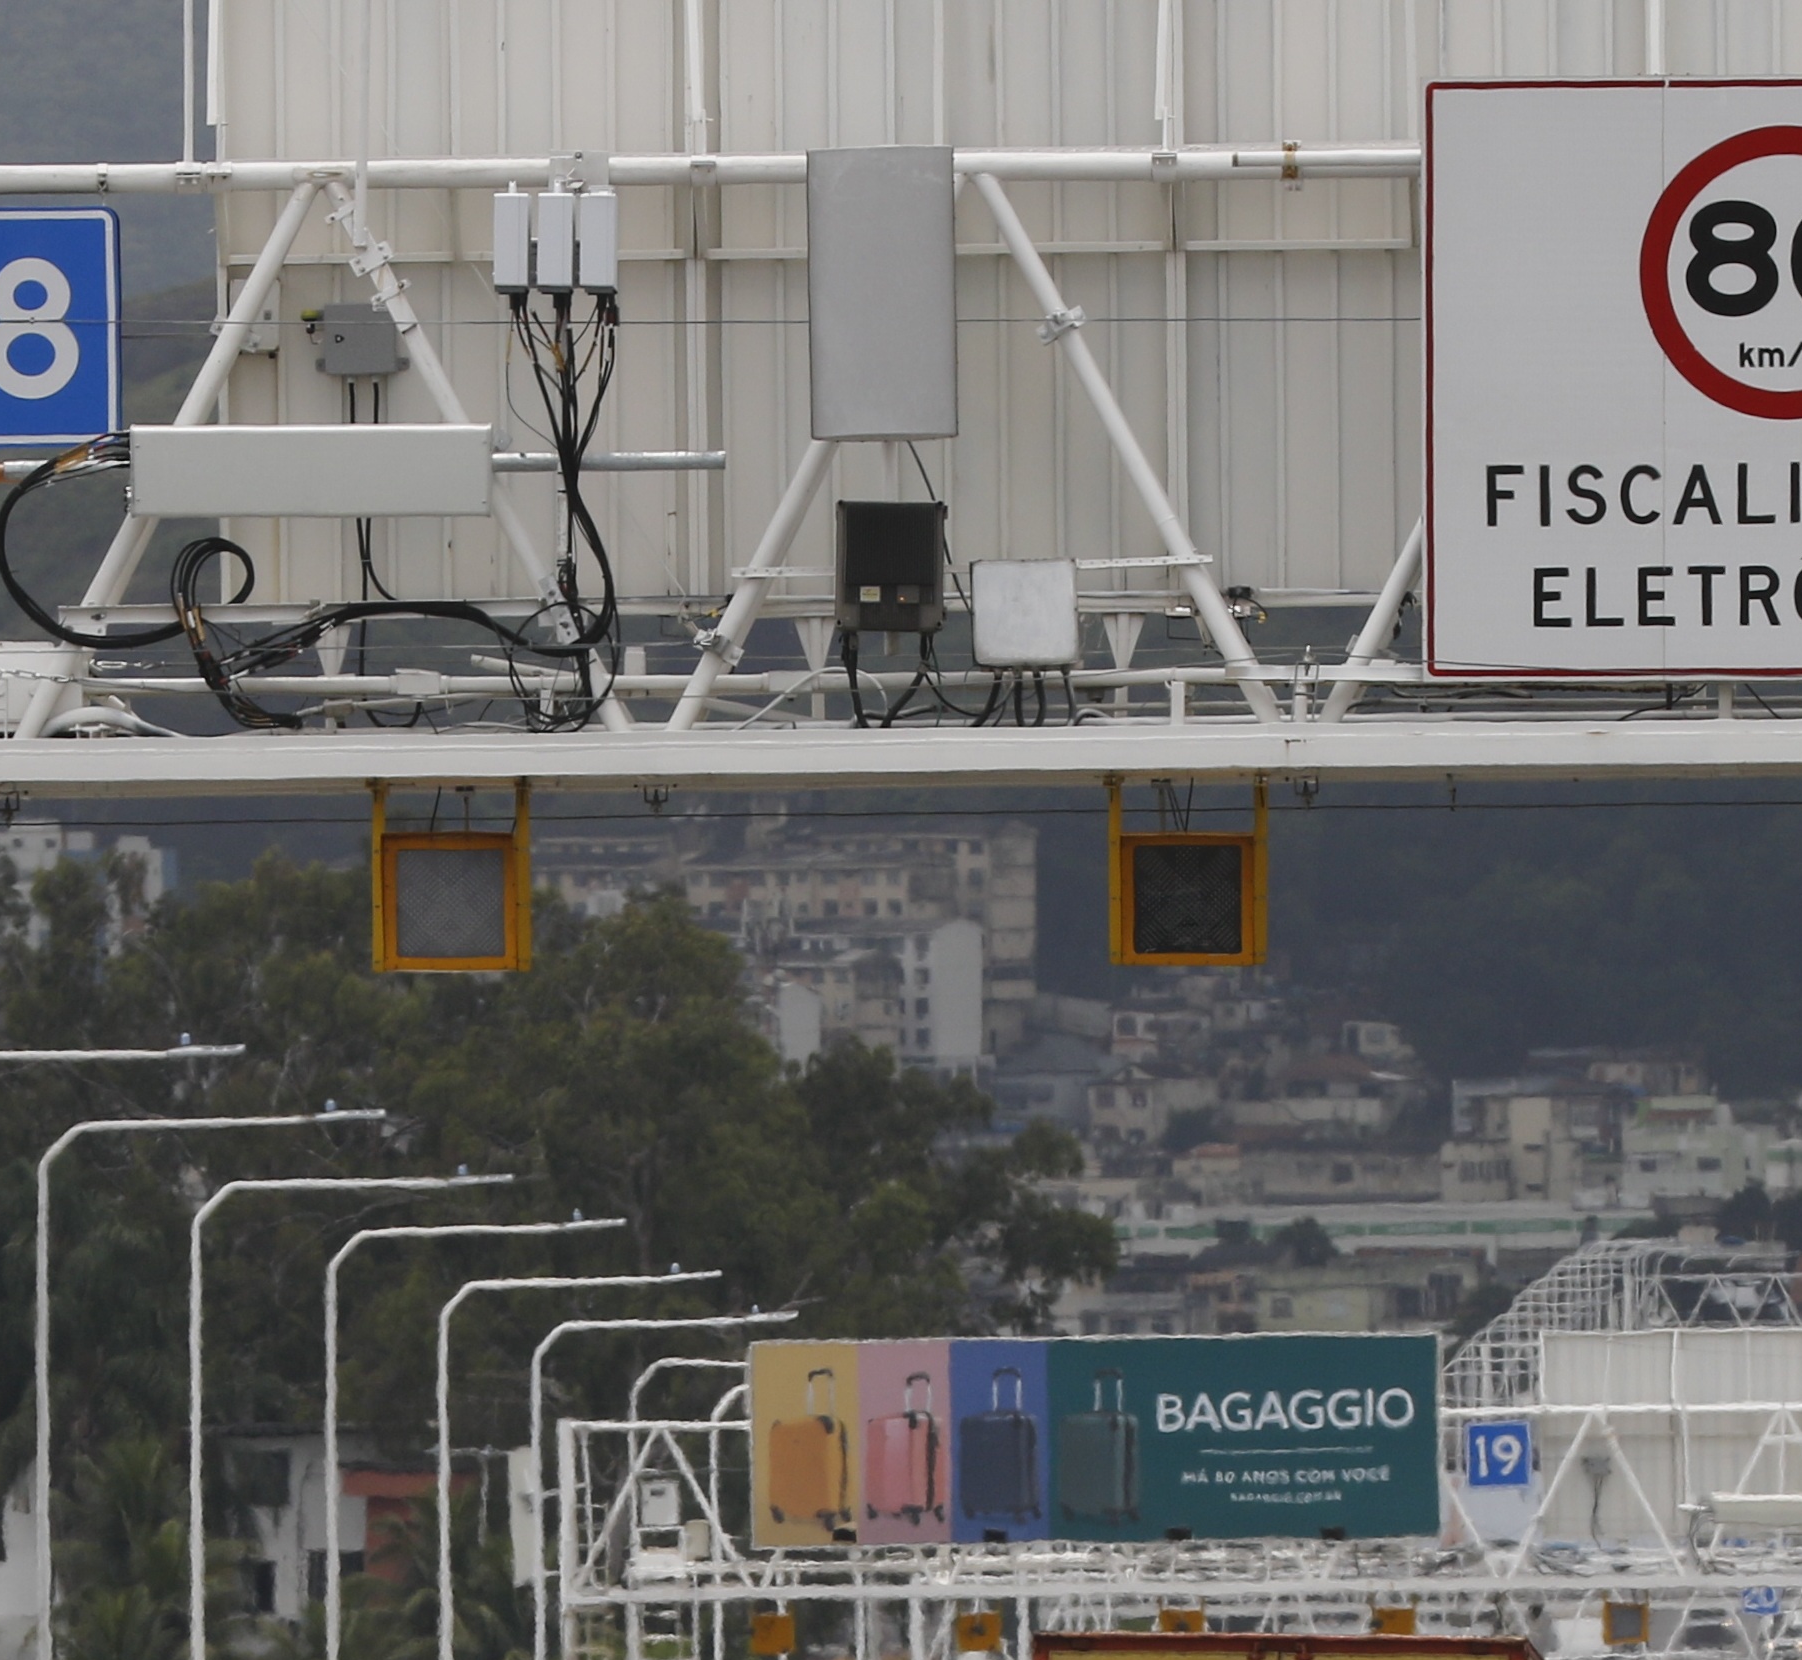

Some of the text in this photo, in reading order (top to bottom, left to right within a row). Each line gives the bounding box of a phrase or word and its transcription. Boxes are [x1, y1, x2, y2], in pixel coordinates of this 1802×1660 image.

[1156, 1387, 1415, 1433] BAGAGGIO
[1242, 1469, 1290, 1484] ANOS
[1294, 1470, 1336, 1484] COM
[1475, 1434, 1523, 1477] 19
